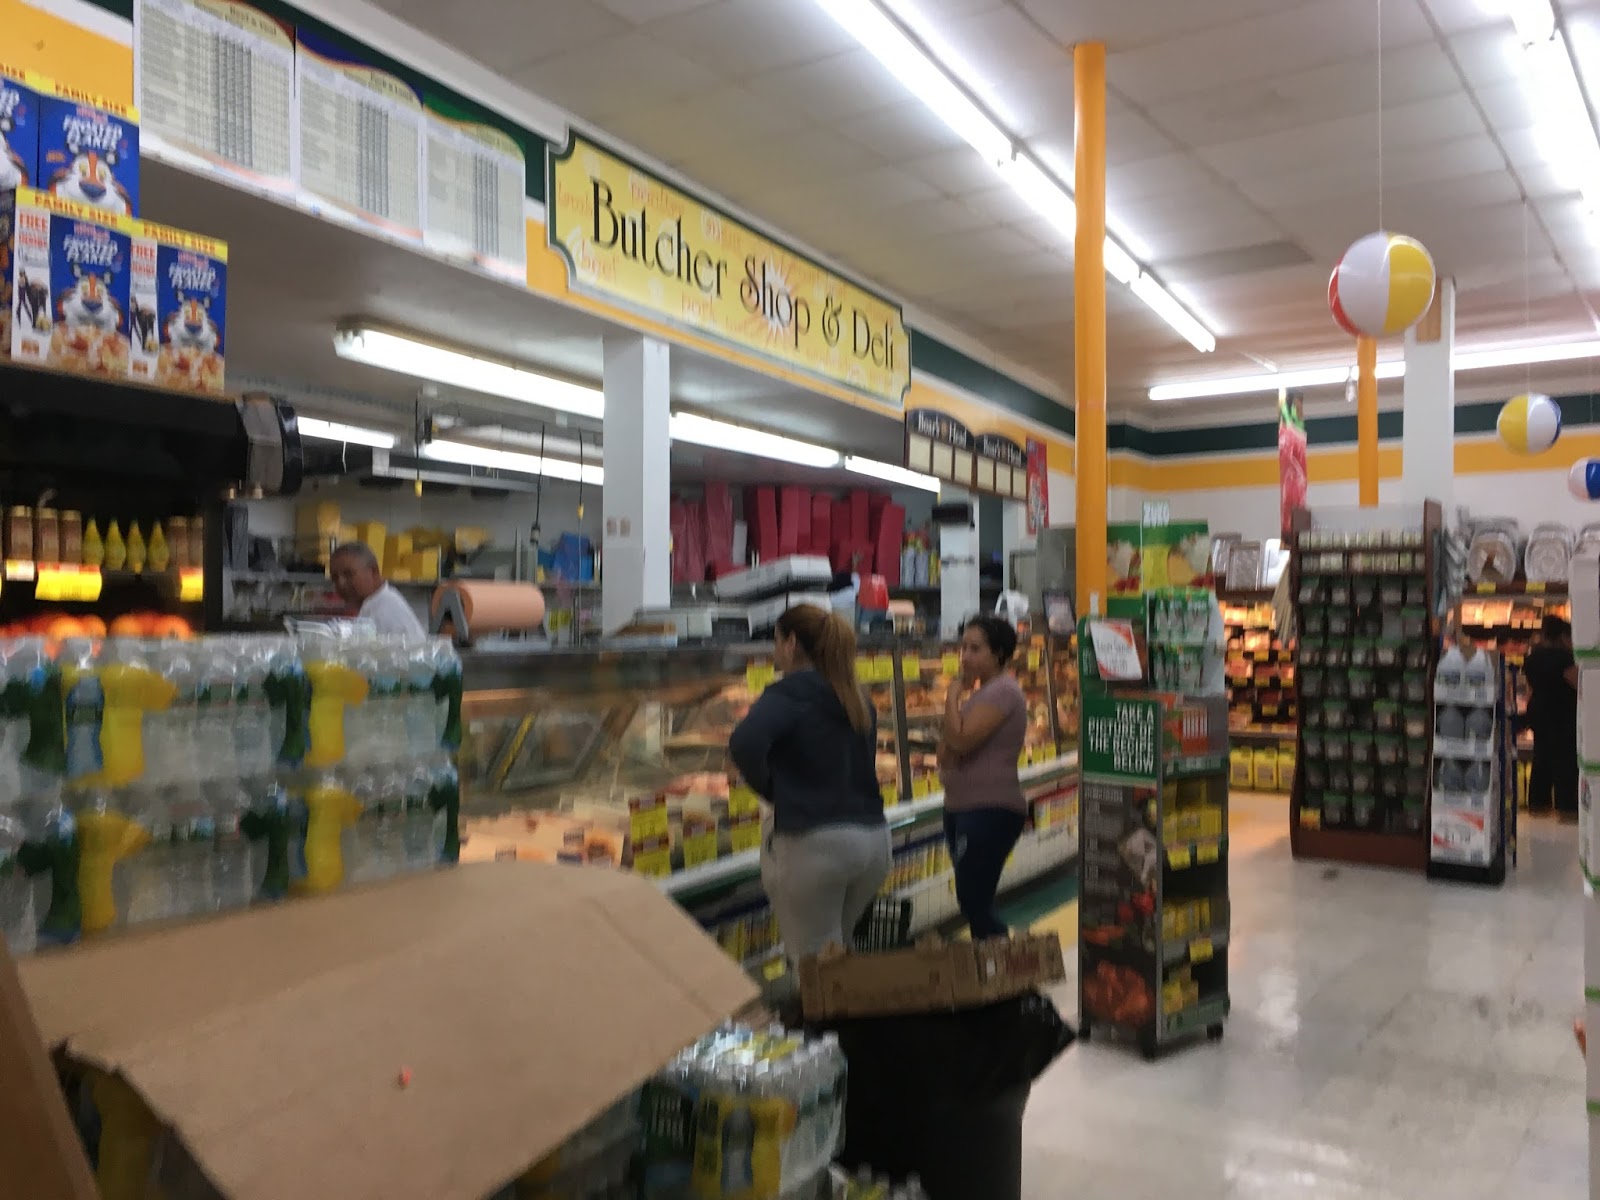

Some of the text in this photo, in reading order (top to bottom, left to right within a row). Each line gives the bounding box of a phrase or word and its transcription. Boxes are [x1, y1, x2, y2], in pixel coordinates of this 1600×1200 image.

[35, 191, 117, 226] FAMILY SIZE
[590, 175, 728, 299] Butcher
[739, 253, 811, 350] Shop
[821, 292, 843, 347] &
[852, 309, 894, 371] Deli
[1115, 702, 1154, 725] TAKE A
[1088, 715, 1136, 739] PICTURE
[1089, 734, 1154, 757] THE RECIPE
[1113, 752, 1154, 774] BELOW
